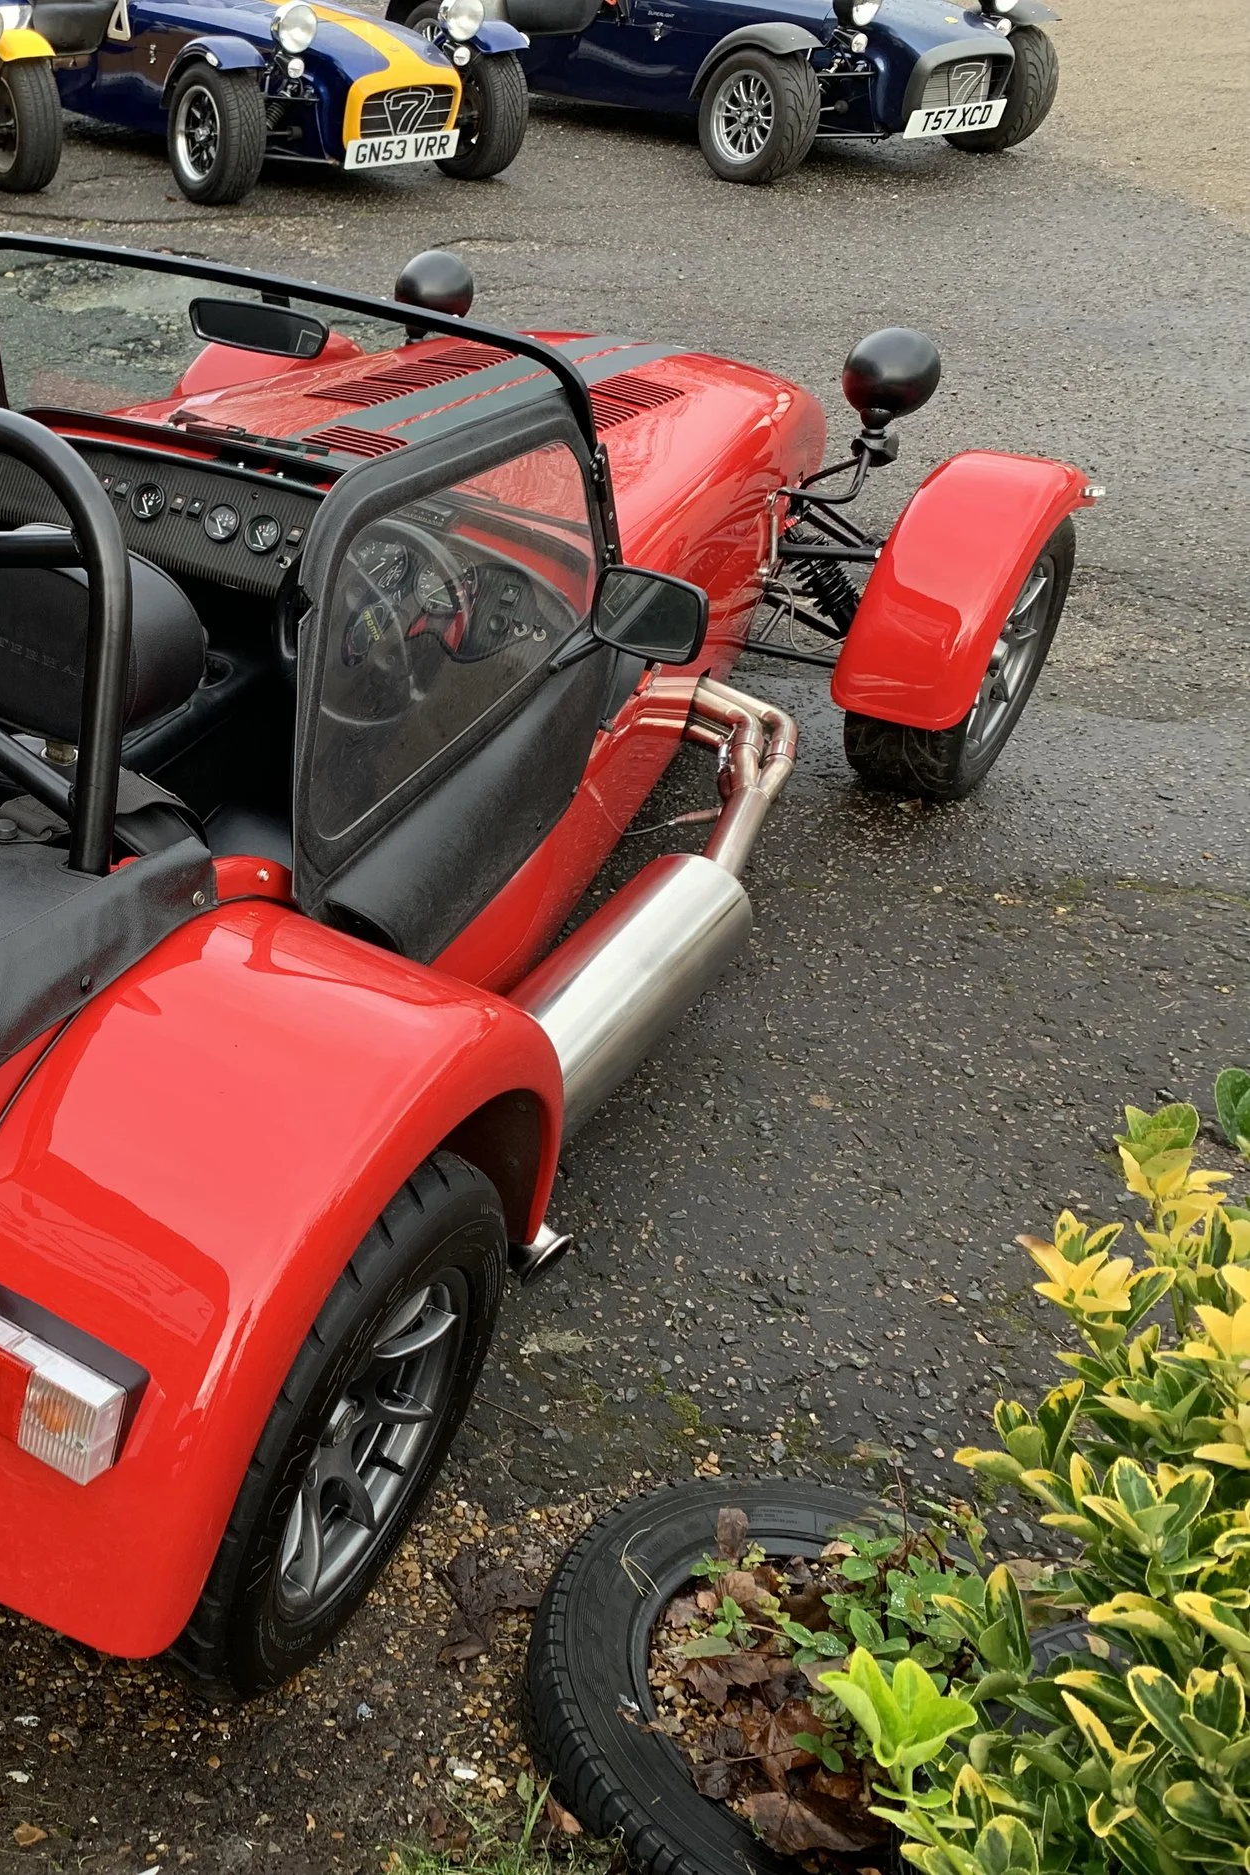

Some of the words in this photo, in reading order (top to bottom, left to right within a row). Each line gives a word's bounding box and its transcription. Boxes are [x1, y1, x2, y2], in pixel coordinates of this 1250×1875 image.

[390, 91, 428, 135] 7
[922, 109, 957, 132] T57
[956, 104, 993, 128] XCD
[355, 139, 407, 164] GN53
[414, 135, 450, 158] VRR
